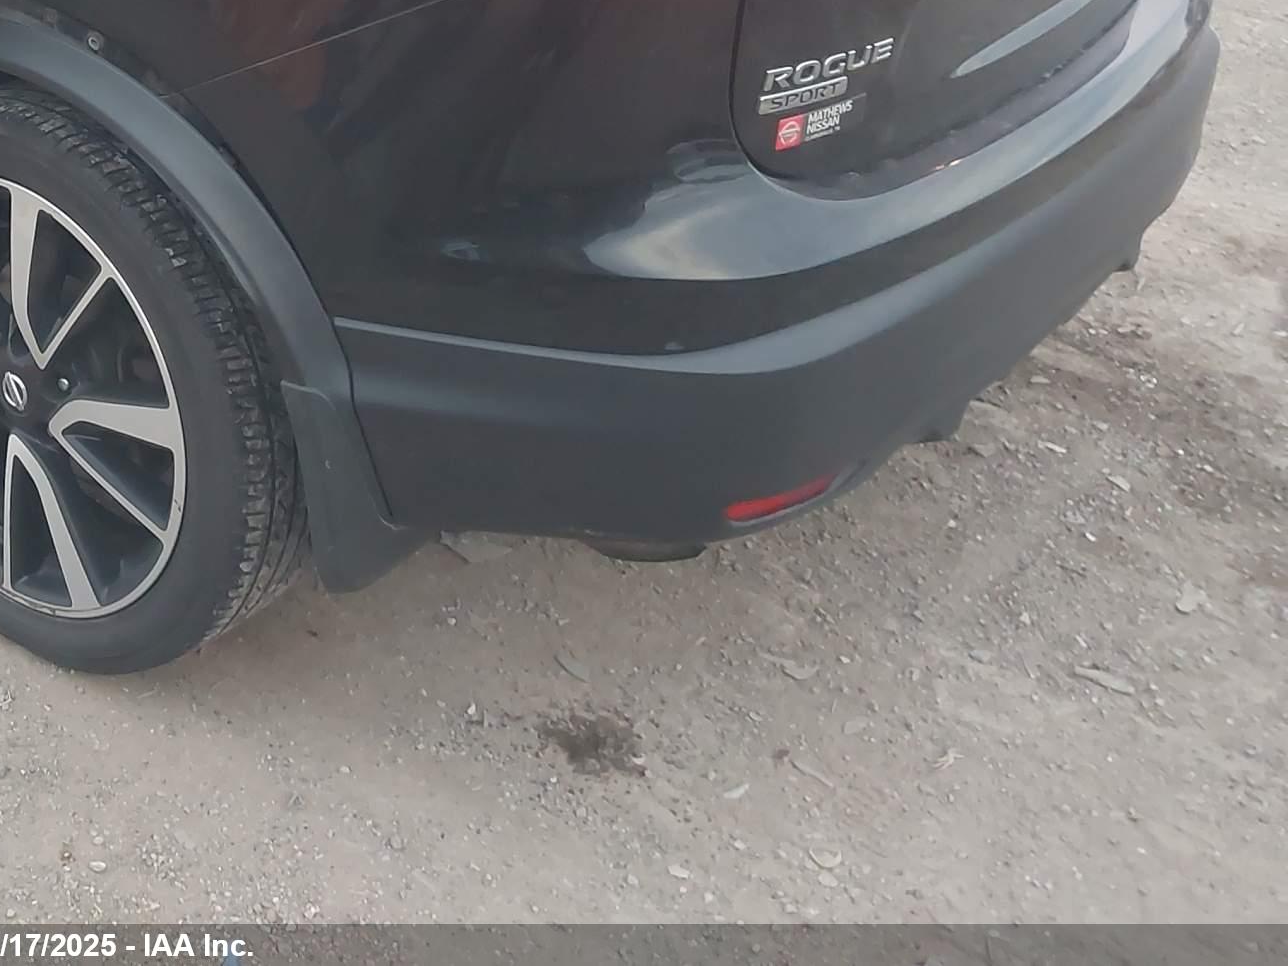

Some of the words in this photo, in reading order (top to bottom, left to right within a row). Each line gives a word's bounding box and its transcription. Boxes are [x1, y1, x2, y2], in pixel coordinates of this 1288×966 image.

[763, 37, 893, 91] ROGUE
[770, 83, 843, 109] SPORT
[808, 100, 853, 124] MATHEWS
[806, 115, 840, 135] NISSAN
